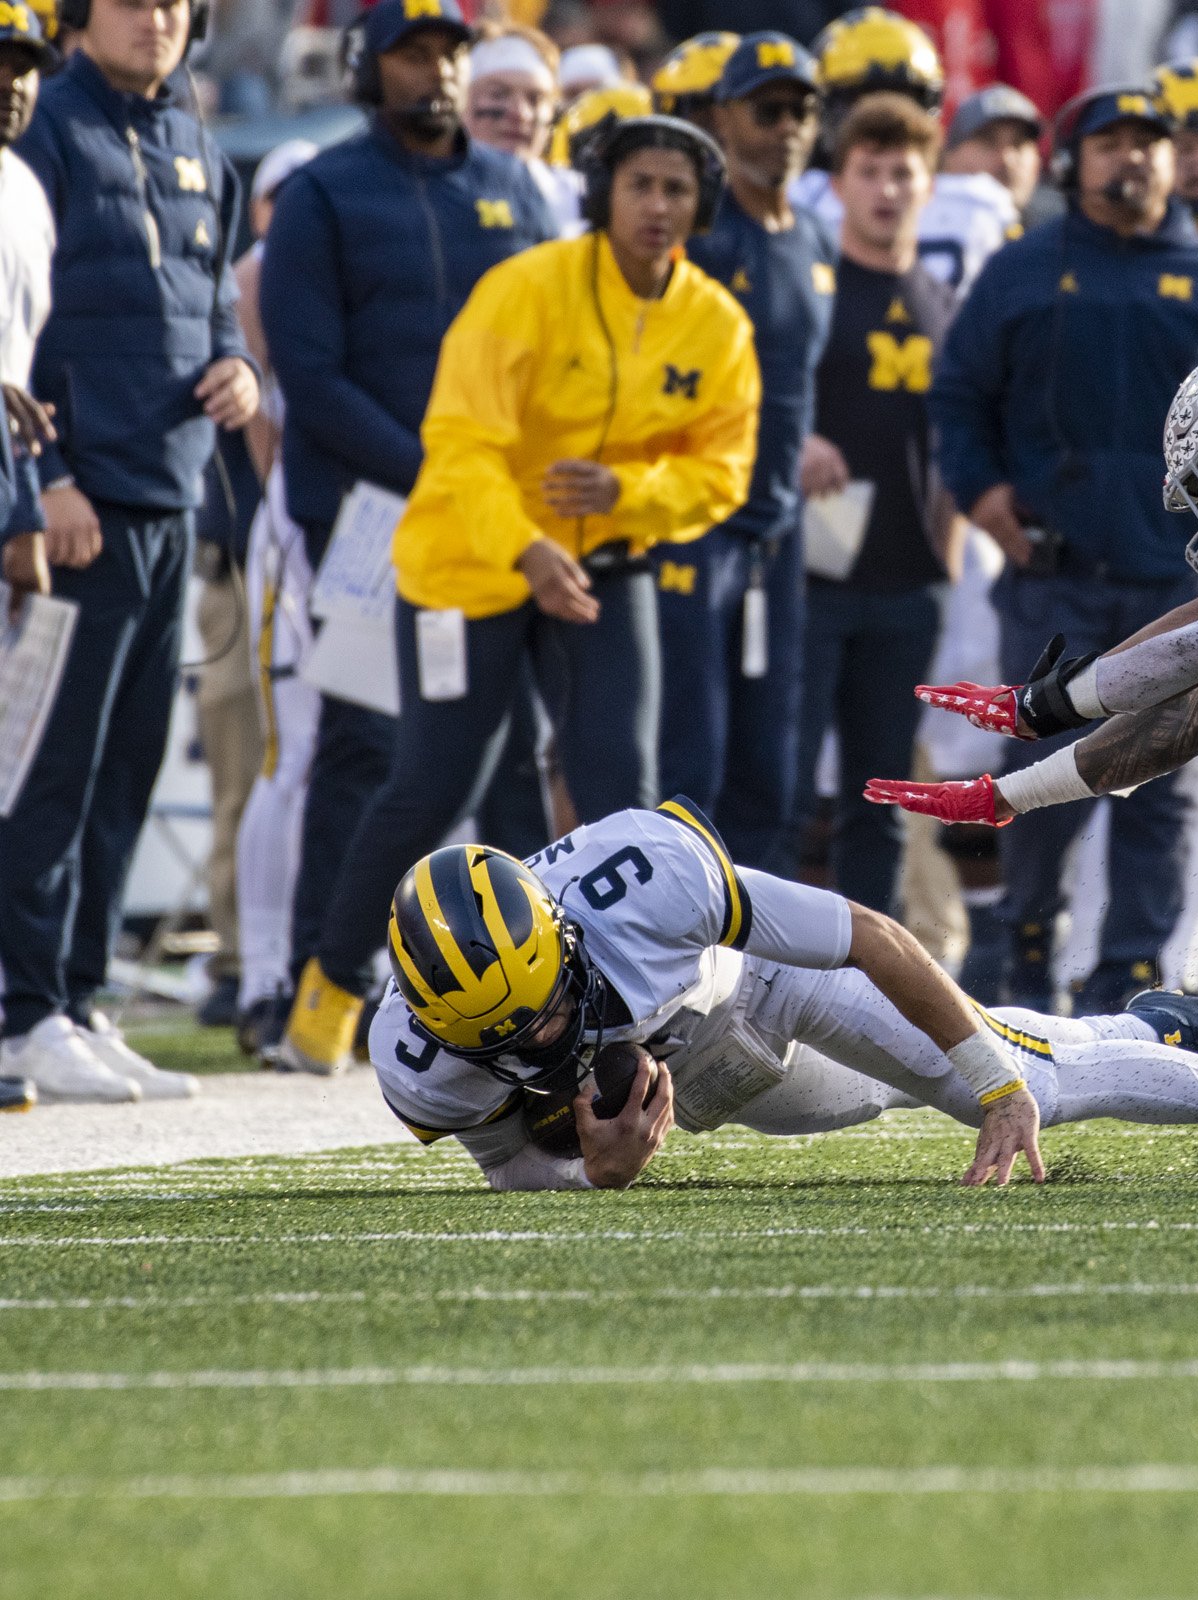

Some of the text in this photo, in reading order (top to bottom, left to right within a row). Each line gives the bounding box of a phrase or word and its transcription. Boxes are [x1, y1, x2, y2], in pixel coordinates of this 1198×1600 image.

[475, 198, 513, 228] M
[866, 329, 932, 393] M
[662, 363, 702, 400] M
[659, 560, 696, 596] M
[494, 1018, 517, 1037] M
